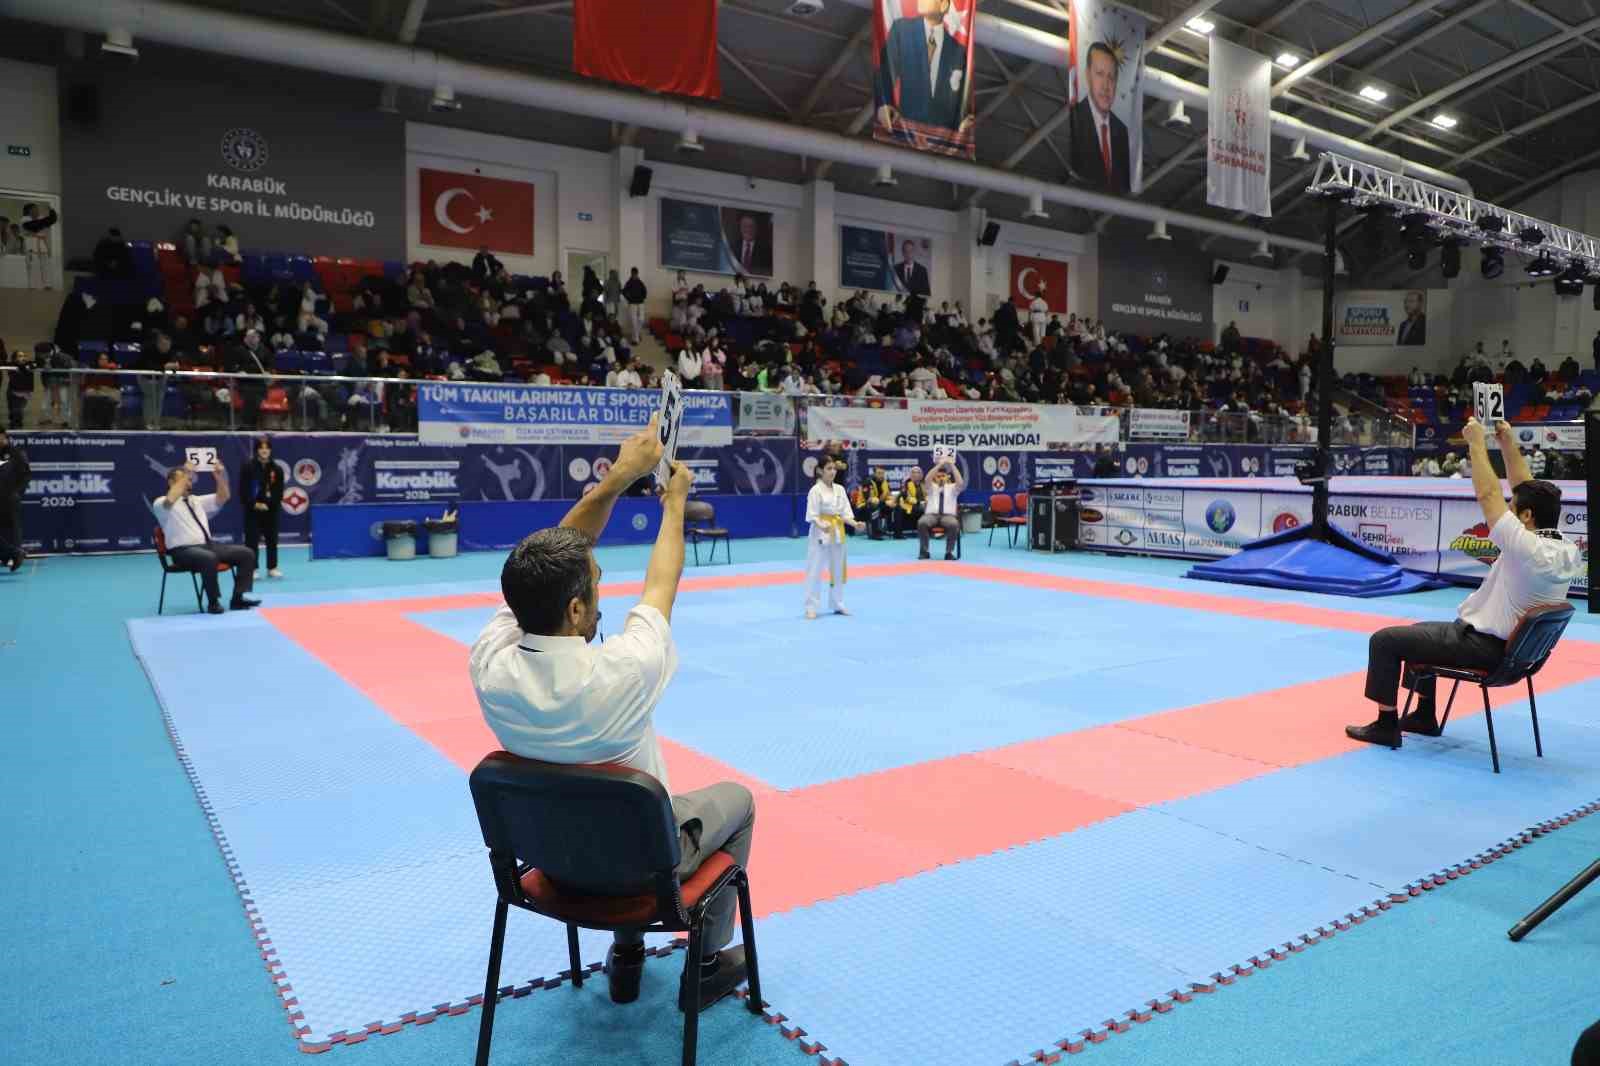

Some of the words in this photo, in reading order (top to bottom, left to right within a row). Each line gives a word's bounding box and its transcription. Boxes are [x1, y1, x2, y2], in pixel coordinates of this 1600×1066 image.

[207, 173, 287, 195] KARABÜK
[106, 186, 182, 207] GENÇLİK
[184, 194, 206, 210] VE
[209, 197, 254, 214] SPOR
[257, 198, 271, 217] İL
[274, 202, 374, 227] MÜDÜRLÜĞÜ
[421, 384, 458, 401] TÜM
[461, 388, 583, 405] TAKIMLARIMIZA
[587, 392, 607, 407] VE
[1490, 391, 1503, 418] 2
[504, 406, 599, 423] BAŞARILAR
[895, 434, 930, 447] GSB
[933, 434, 965, 446] HEP
[968, 433, 1040, 446] YANINDA!
[190, 453, 199, 466] 5
[206, 452, 216, 465] 2
[375, 472, 458, 489] Karabük
[41, 496, 75, 507] 2026
